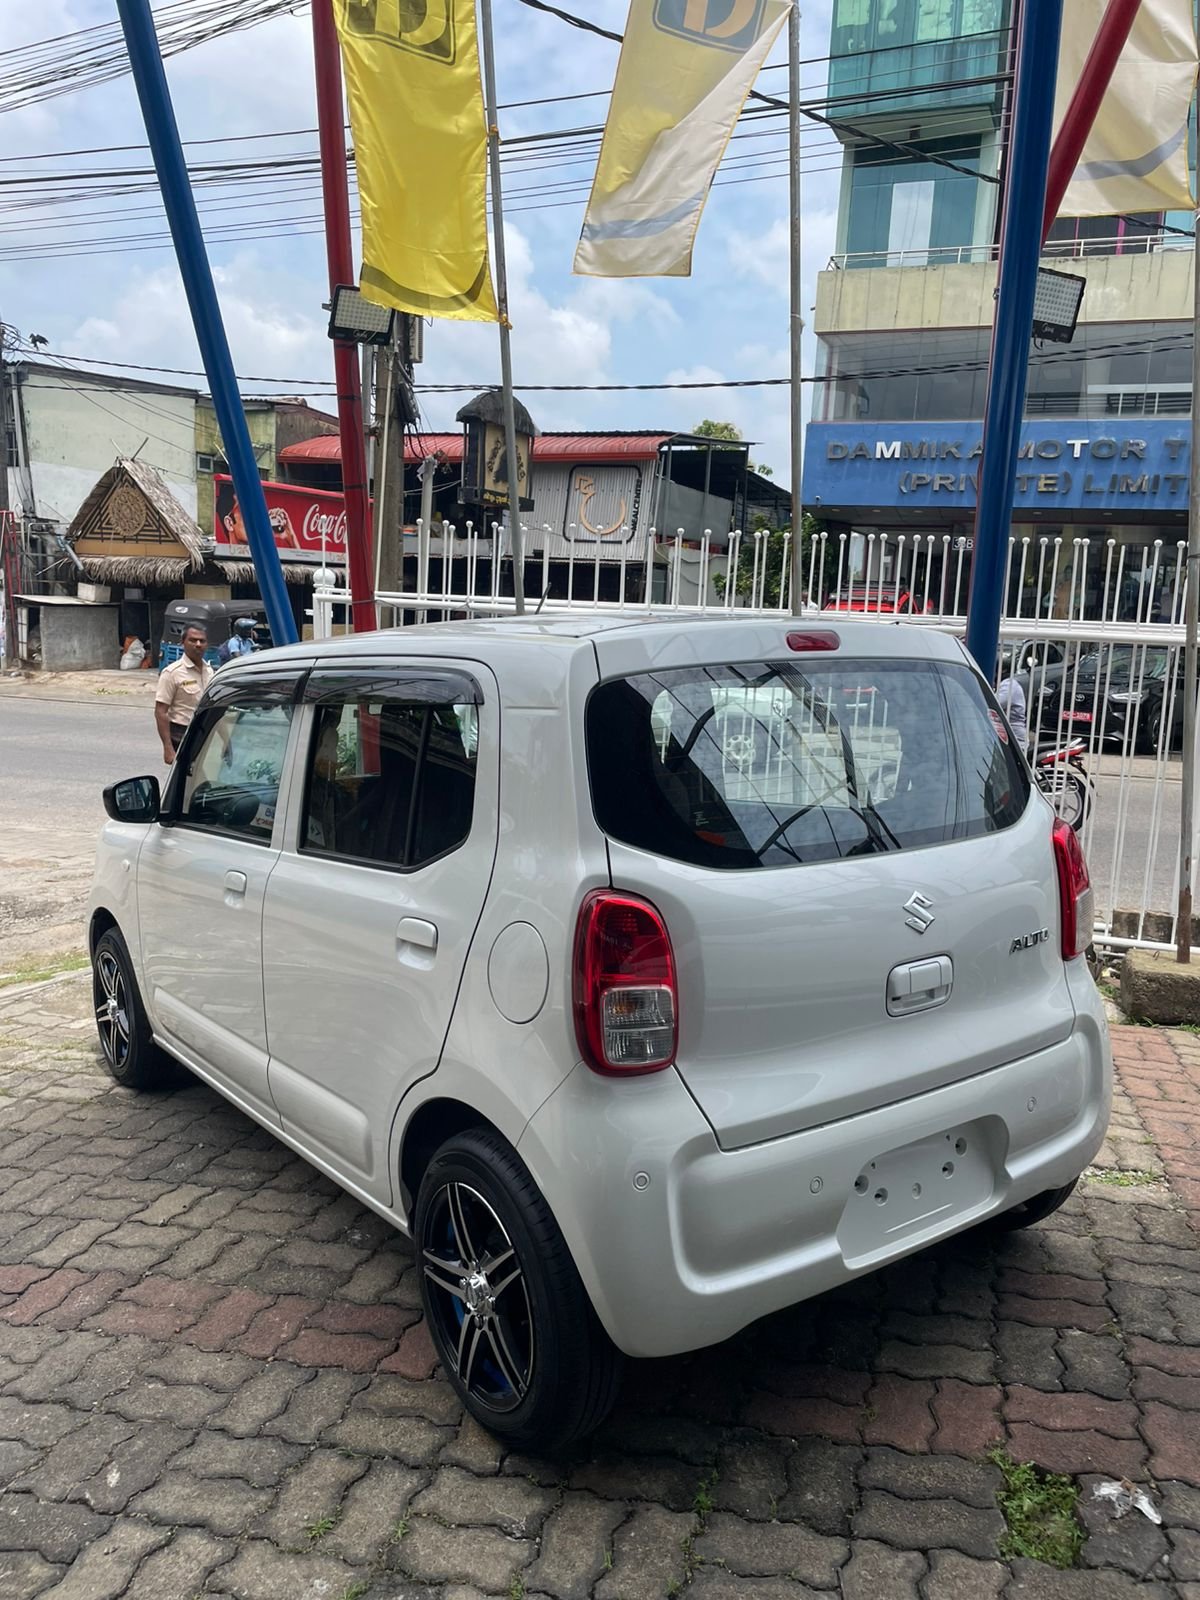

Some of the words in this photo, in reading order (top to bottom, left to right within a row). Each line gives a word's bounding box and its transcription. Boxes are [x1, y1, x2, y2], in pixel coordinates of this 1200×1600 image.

[1018, 438, 1147, 460] MOTOR
[899, 470, 1073, 494] (PRITE)
[1084, 472, 1190, 493] LIMIT
[303, 503, 347, 544] Coca-Co
[1009, 927, 1050, 955] ALTO
